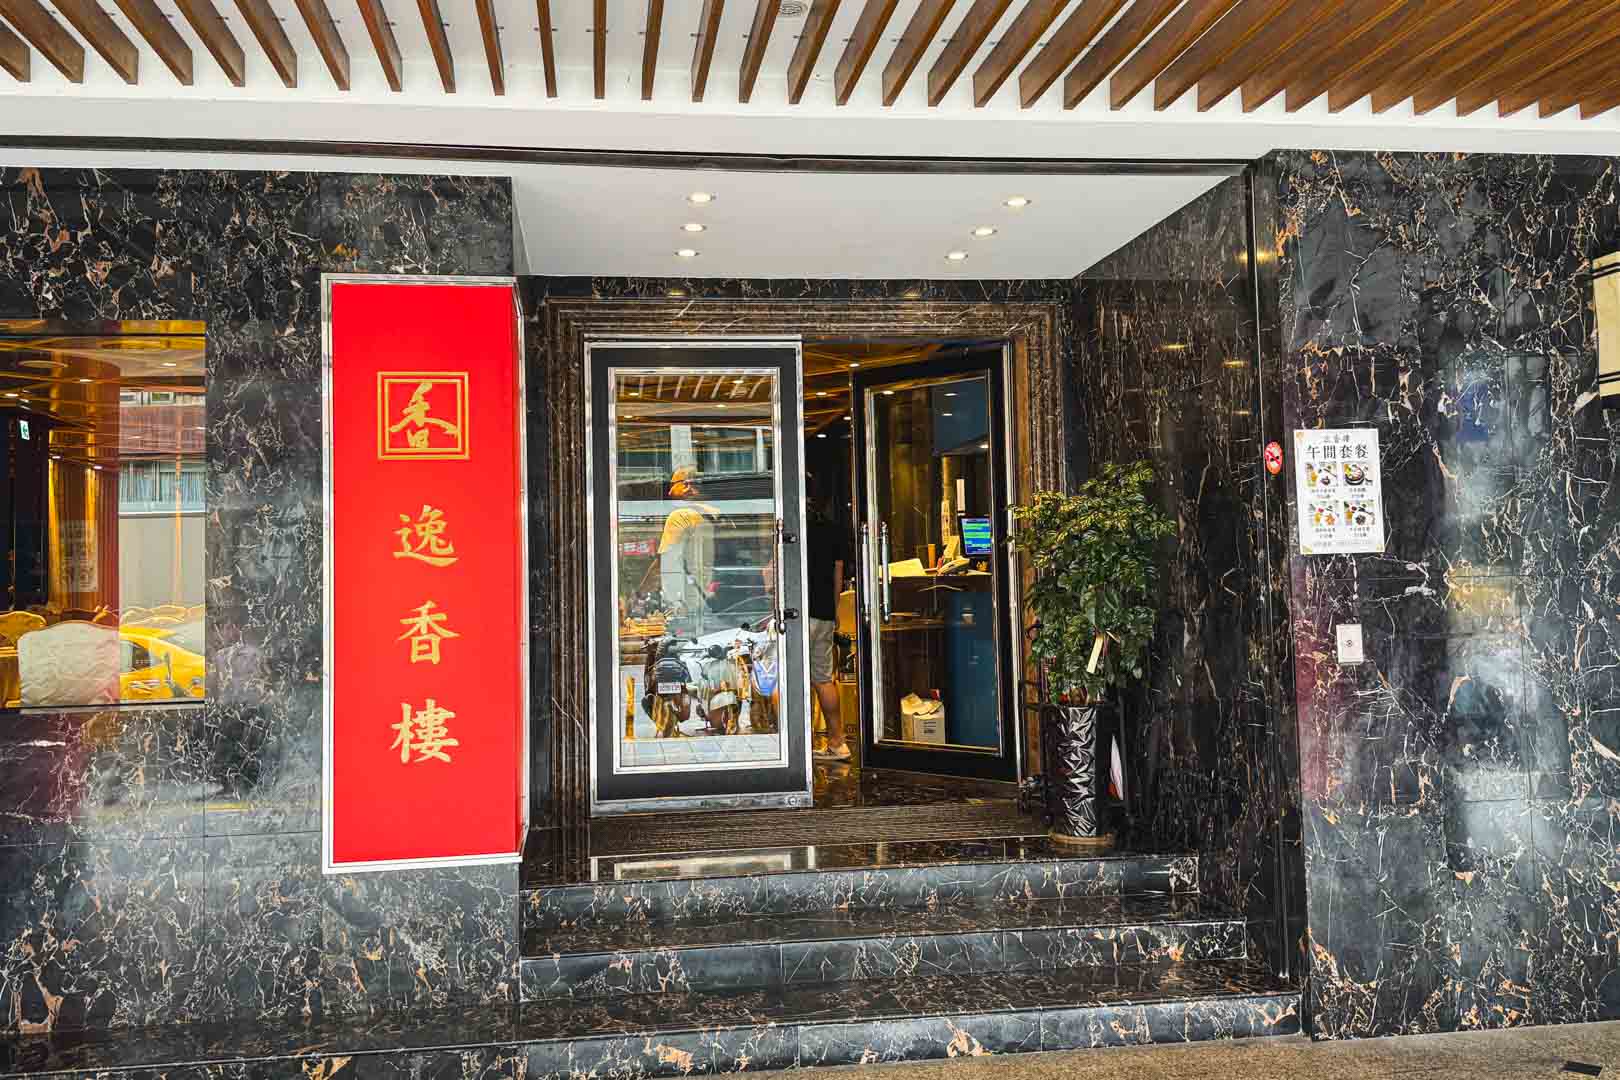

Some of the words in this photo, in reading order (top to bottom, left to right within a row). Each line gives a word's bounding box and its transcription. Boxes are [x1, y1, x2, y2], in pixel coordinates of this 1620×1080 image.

[1305, 444, 1369, 460] 午間套餐
[391, 505, 459, 763] 逸香樓
